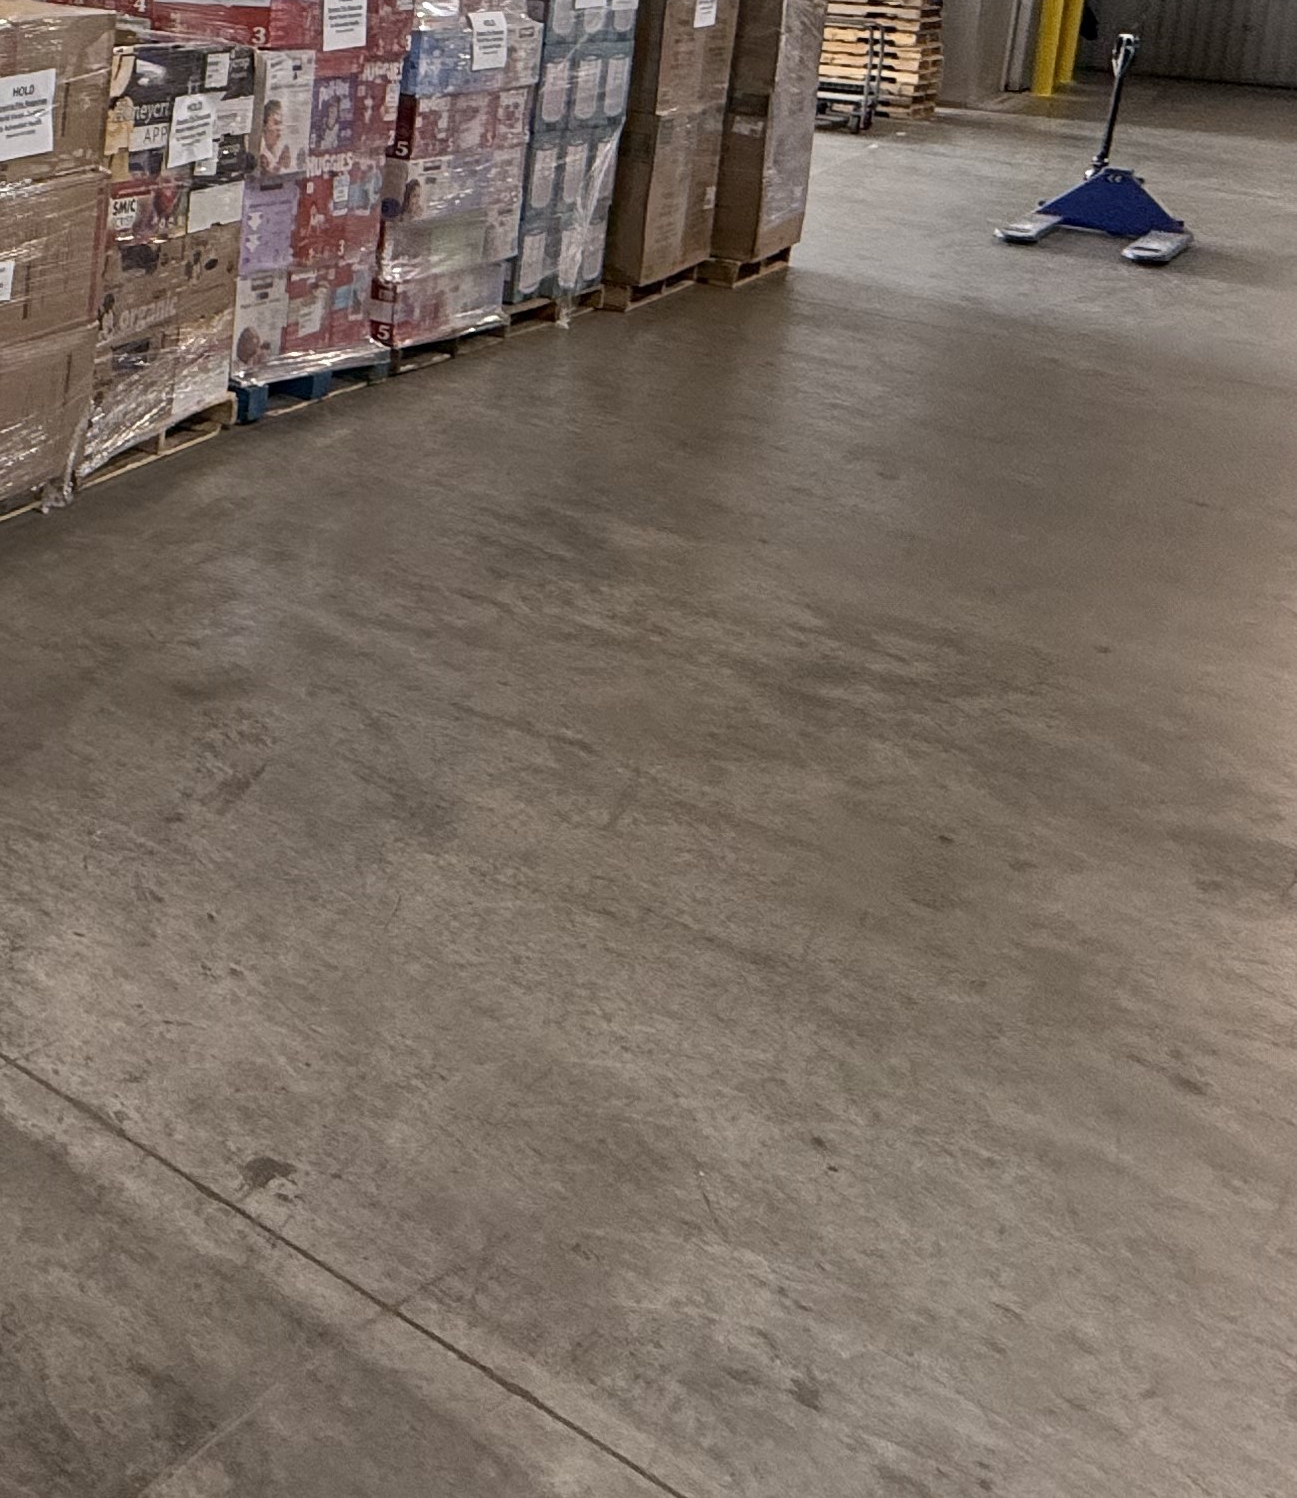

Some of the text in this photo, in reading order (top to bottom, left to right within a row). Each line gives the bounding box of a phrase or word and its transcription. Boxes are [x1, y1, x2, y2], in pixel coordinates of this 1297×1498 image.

[253, 27, 266, 44] 3
[12, 84, 35, 97] HOLD
[395, 141, 408, 156] 5
[377, 325, 390, 340] 5
